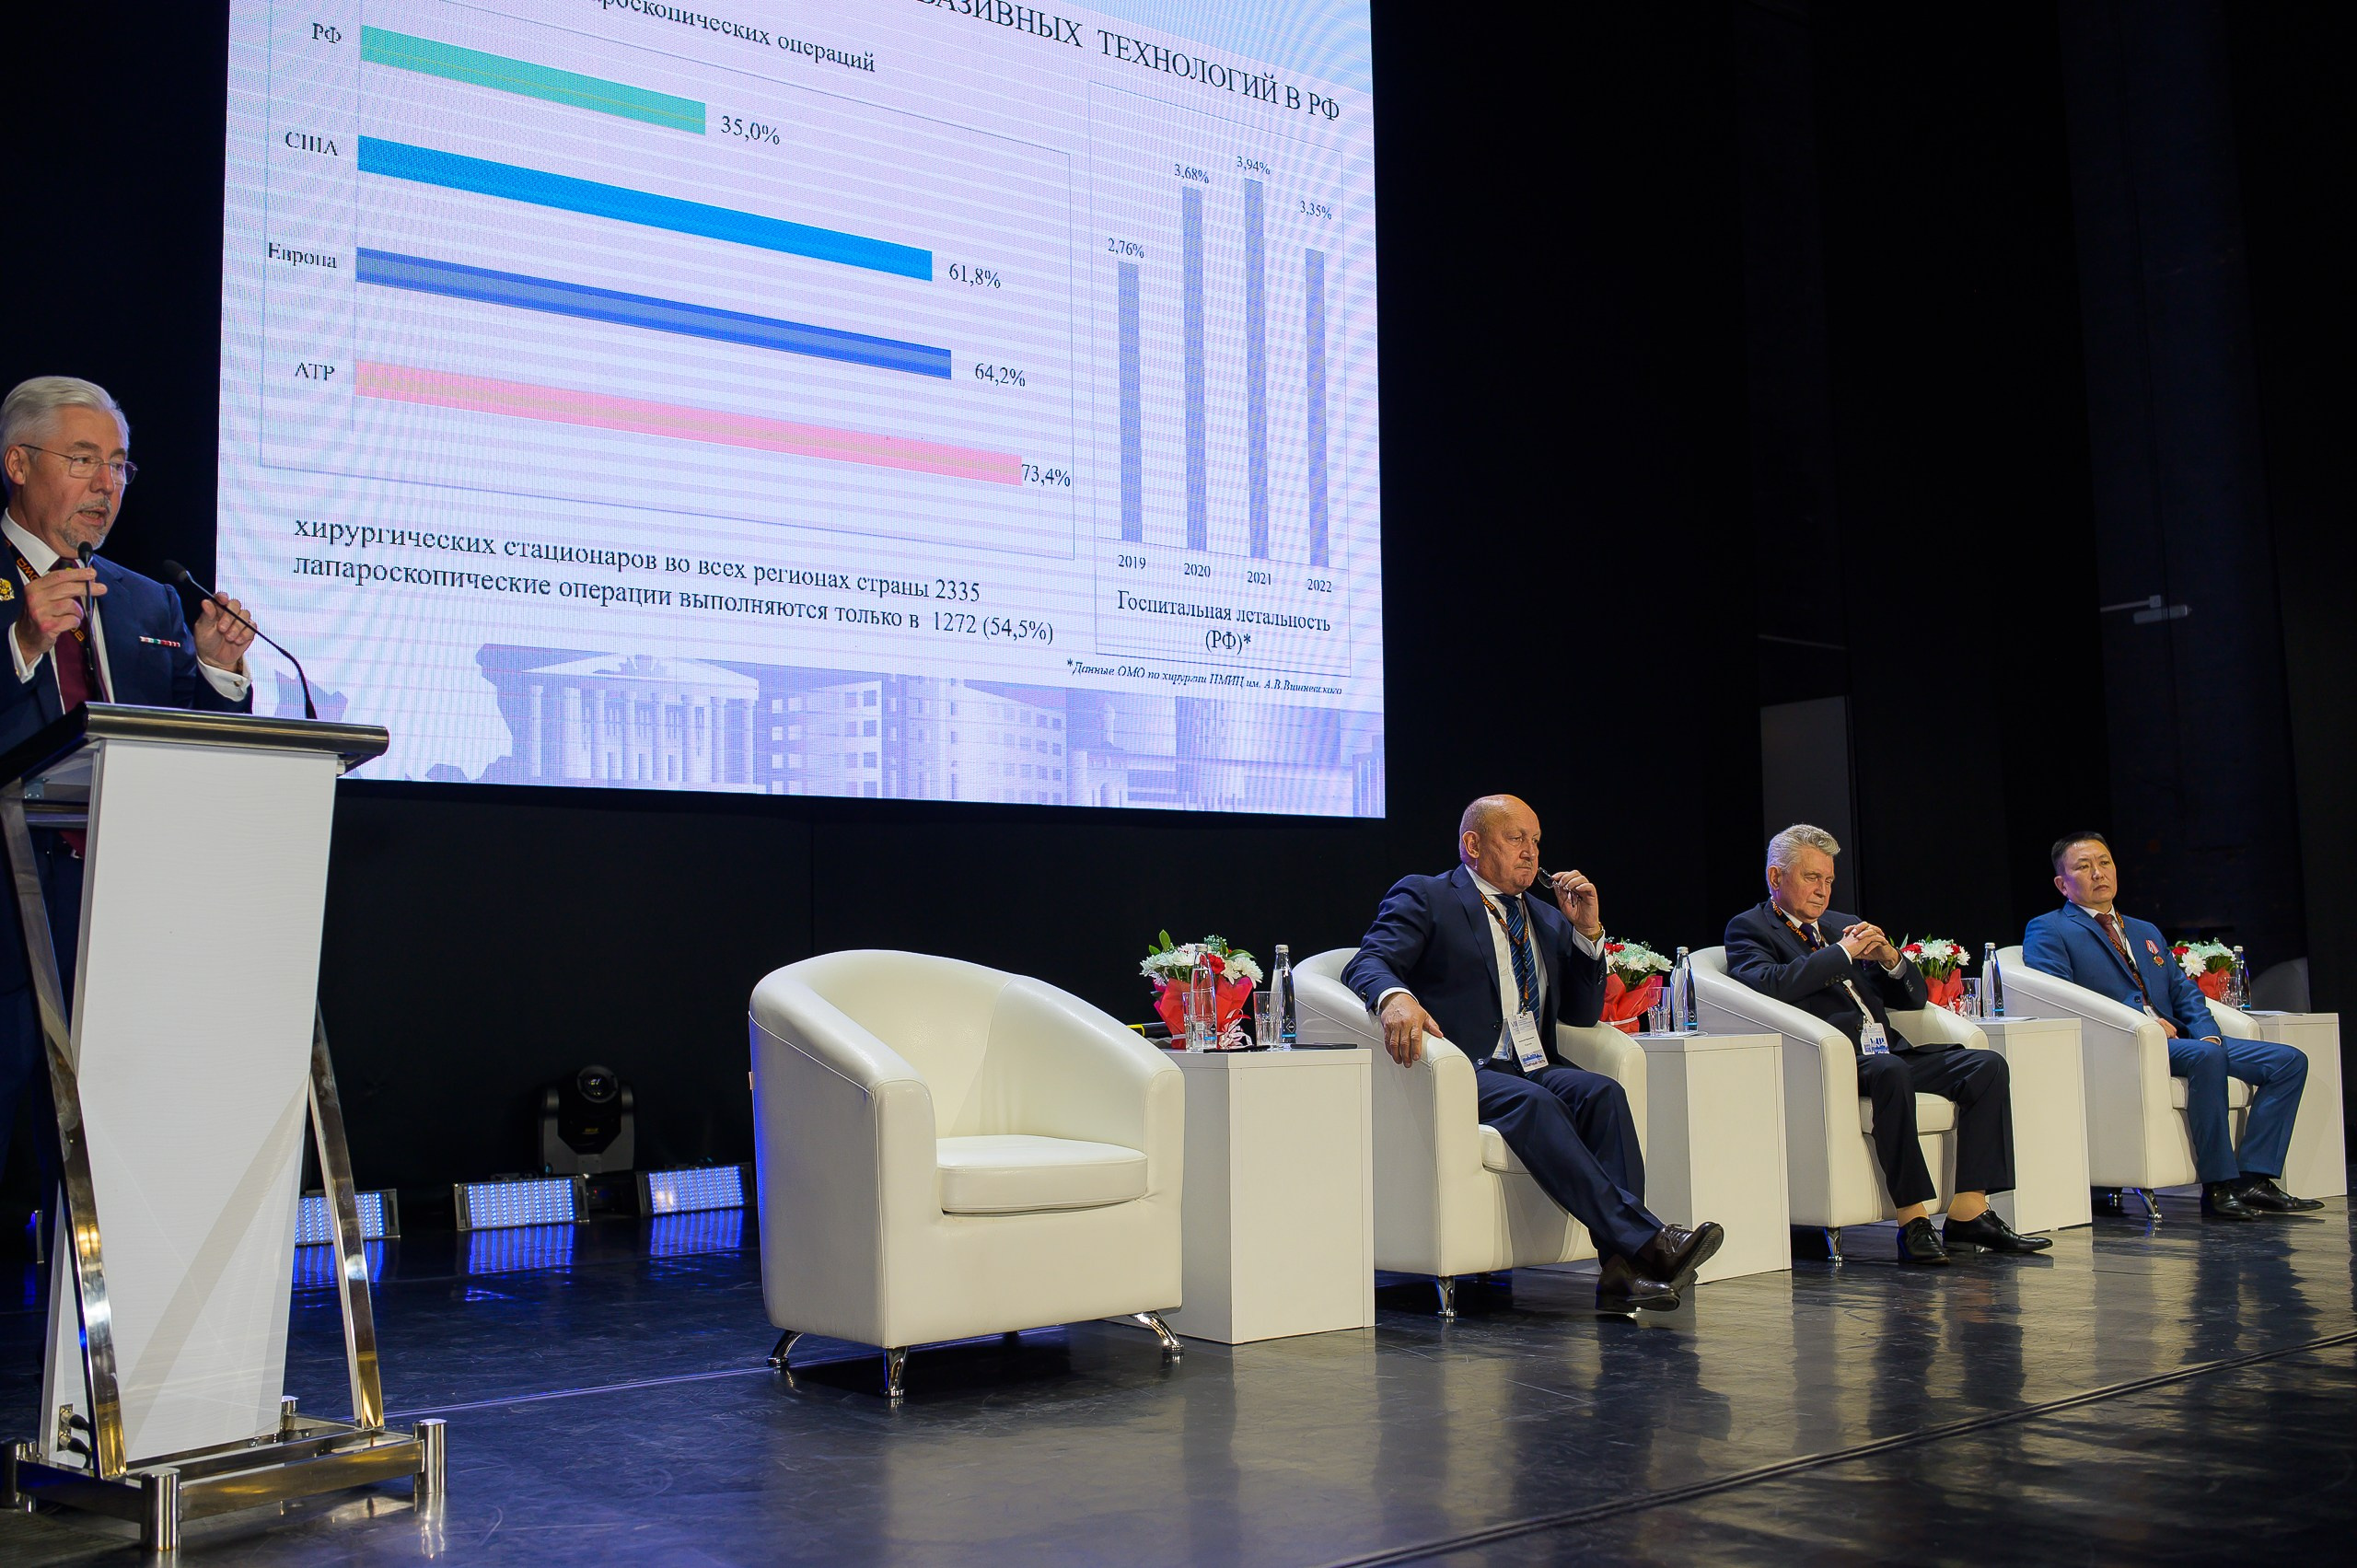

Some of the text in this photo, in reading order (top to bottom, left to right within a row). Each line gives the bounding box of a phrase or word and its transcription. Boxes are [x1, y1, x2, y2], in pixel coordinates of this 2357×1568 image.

[311, 22, 343, 44] РФ
[592, 0, 876, 73] роскопических операций
[917, 0, 1340, 122] ЗИВНЫХ ТЕХНОЛОГИЙ В РФ
[721, 115, 781, 145] 35,0%
[284, 131, 338, 157] США
[1174, 163, 1210, 184] 3,68%
[1237, 156, 1271, 175] 3,94%
[1299, 200, 1332, 221] 3,35%
[268, 241, 337, 269] Европа
[1107, 238, 1144, 259] 2,76%
[948, 262, 1001, 289] 61,8%
[295, 362, 335, 381] АТР
[974, 363, 1026, 387] 64,2%
[1021, 463, 1071, 487] 73,4%
[294, 519, 980, 602] хирургических стационаров во всех регионах страны 2335
[1117, 554, 1146, 570] 2019
[1183, 563, 1212, 578] 2020
[1246, 570, 1271, 586] 2021
[1306, 578, 1332, 593] 2022
[293, 555, 1053, 645] лапароскопические операции выполняются только в 1272 (54,5%)
[1117, 589, 1331, 632] Госпитальная летальность
[1117, 665, 1145, 678] ОМО
[1147, 671, 1160, 680] по
